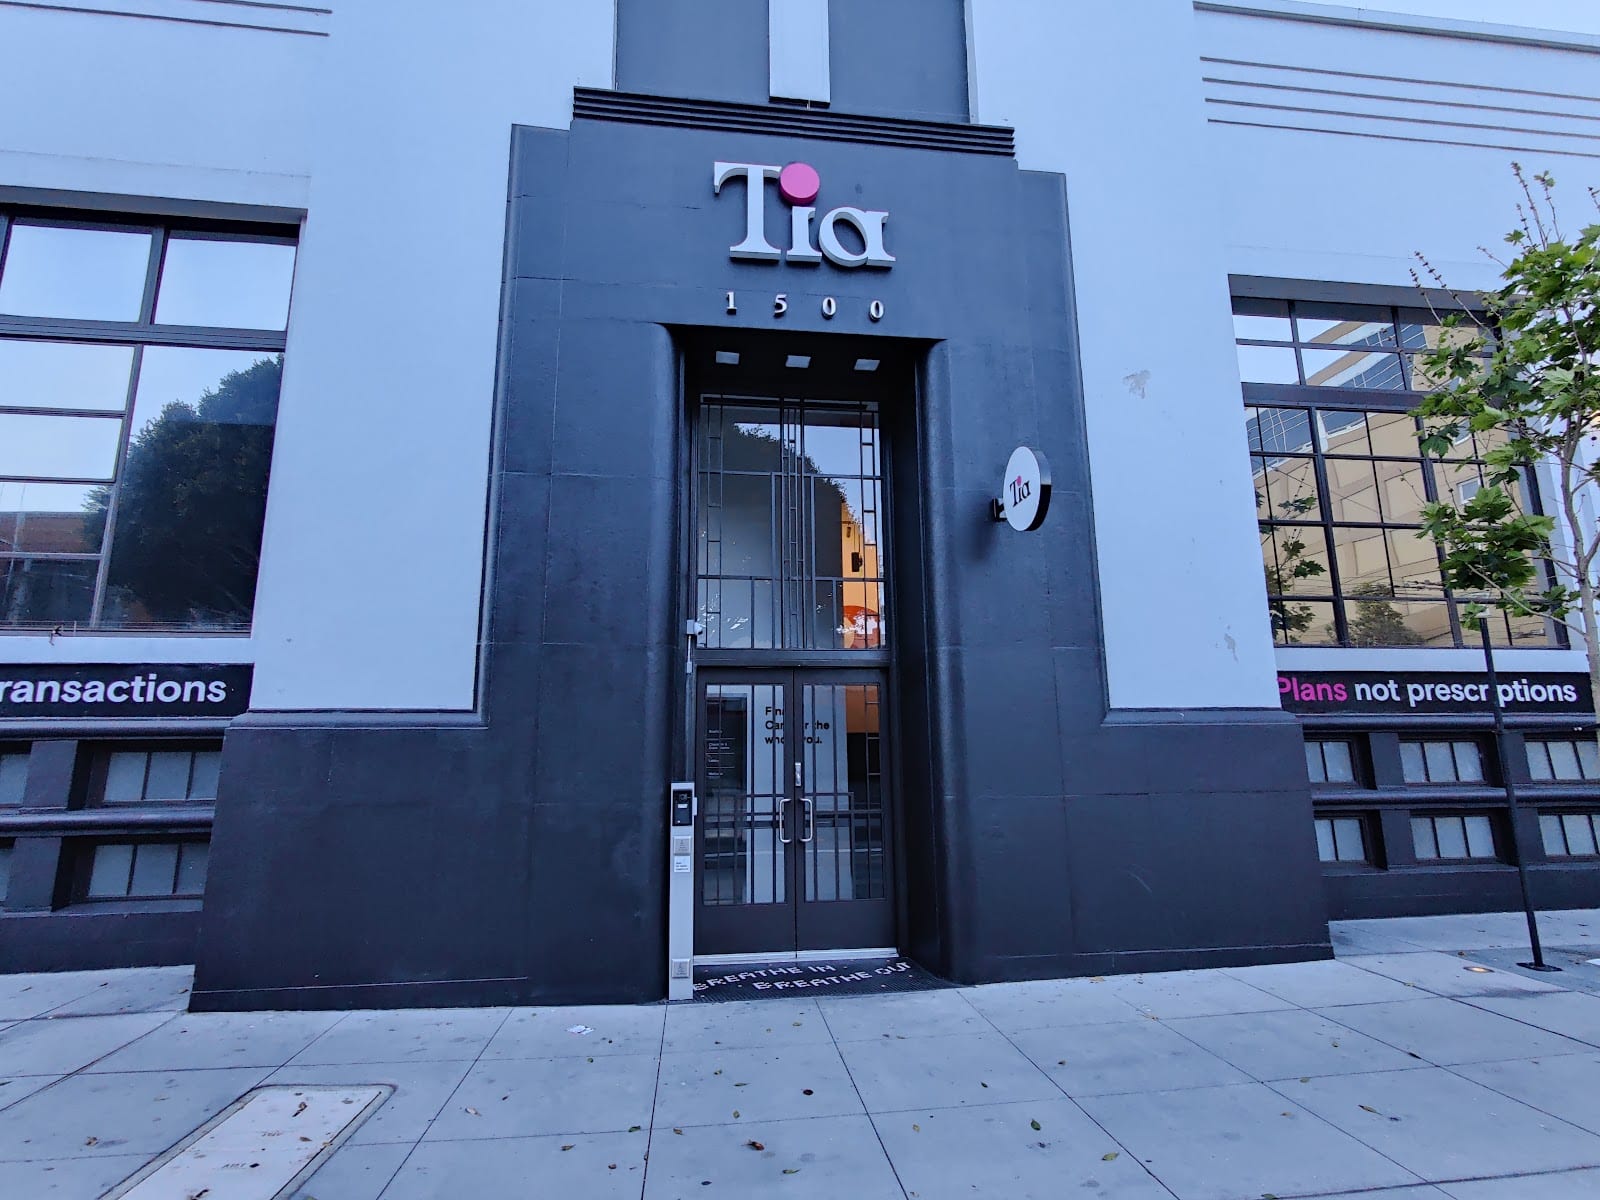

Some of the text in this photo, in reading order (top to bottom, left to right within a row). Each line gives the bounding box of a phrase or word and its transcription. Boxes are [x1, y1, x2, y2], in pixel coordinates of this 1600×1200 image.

[714, 161, 896, 269] Tia
[726, 291, 885, 321] 1500
[1009, 475, 1031, 508] Tia
[1278, 677, 1578, 708] Plans not prescrptions
[752, 971, 873, 990] BREATHE
